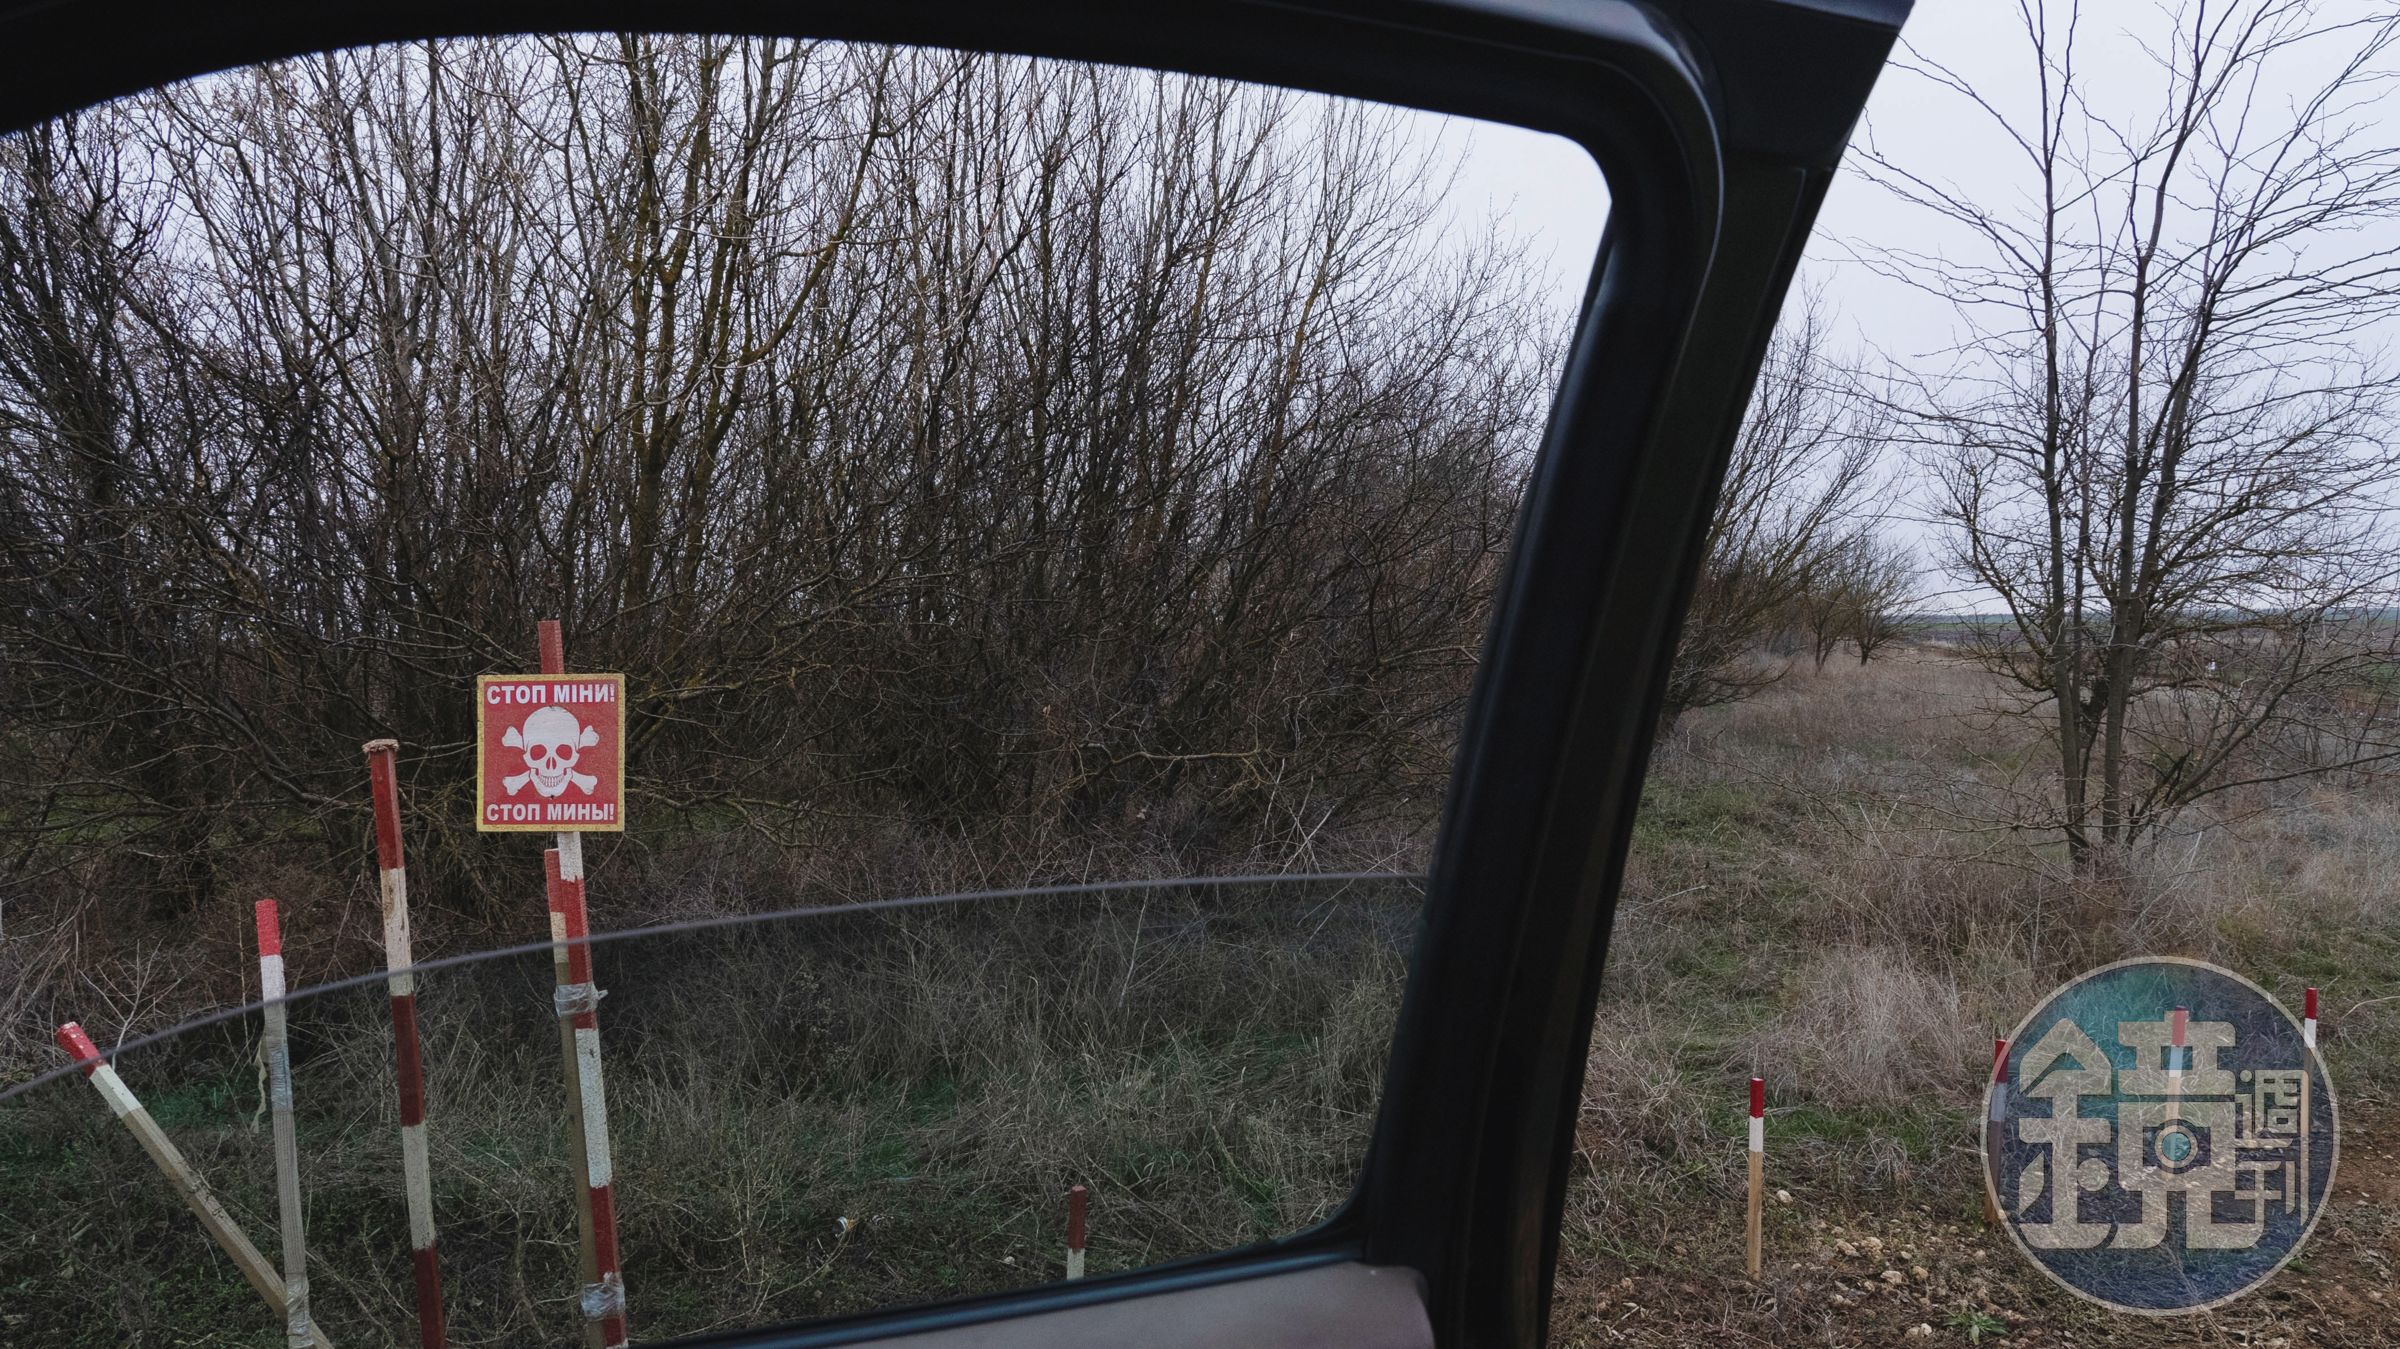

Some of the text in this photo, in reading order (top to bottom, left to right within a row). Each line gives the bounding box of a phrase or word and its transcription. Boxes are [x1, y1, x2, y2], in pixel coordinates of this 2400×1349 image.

[486, 683, 615, 705] СТОП МІНИ!
[486, 803, 614, 821] СТОП МИНЫ!
